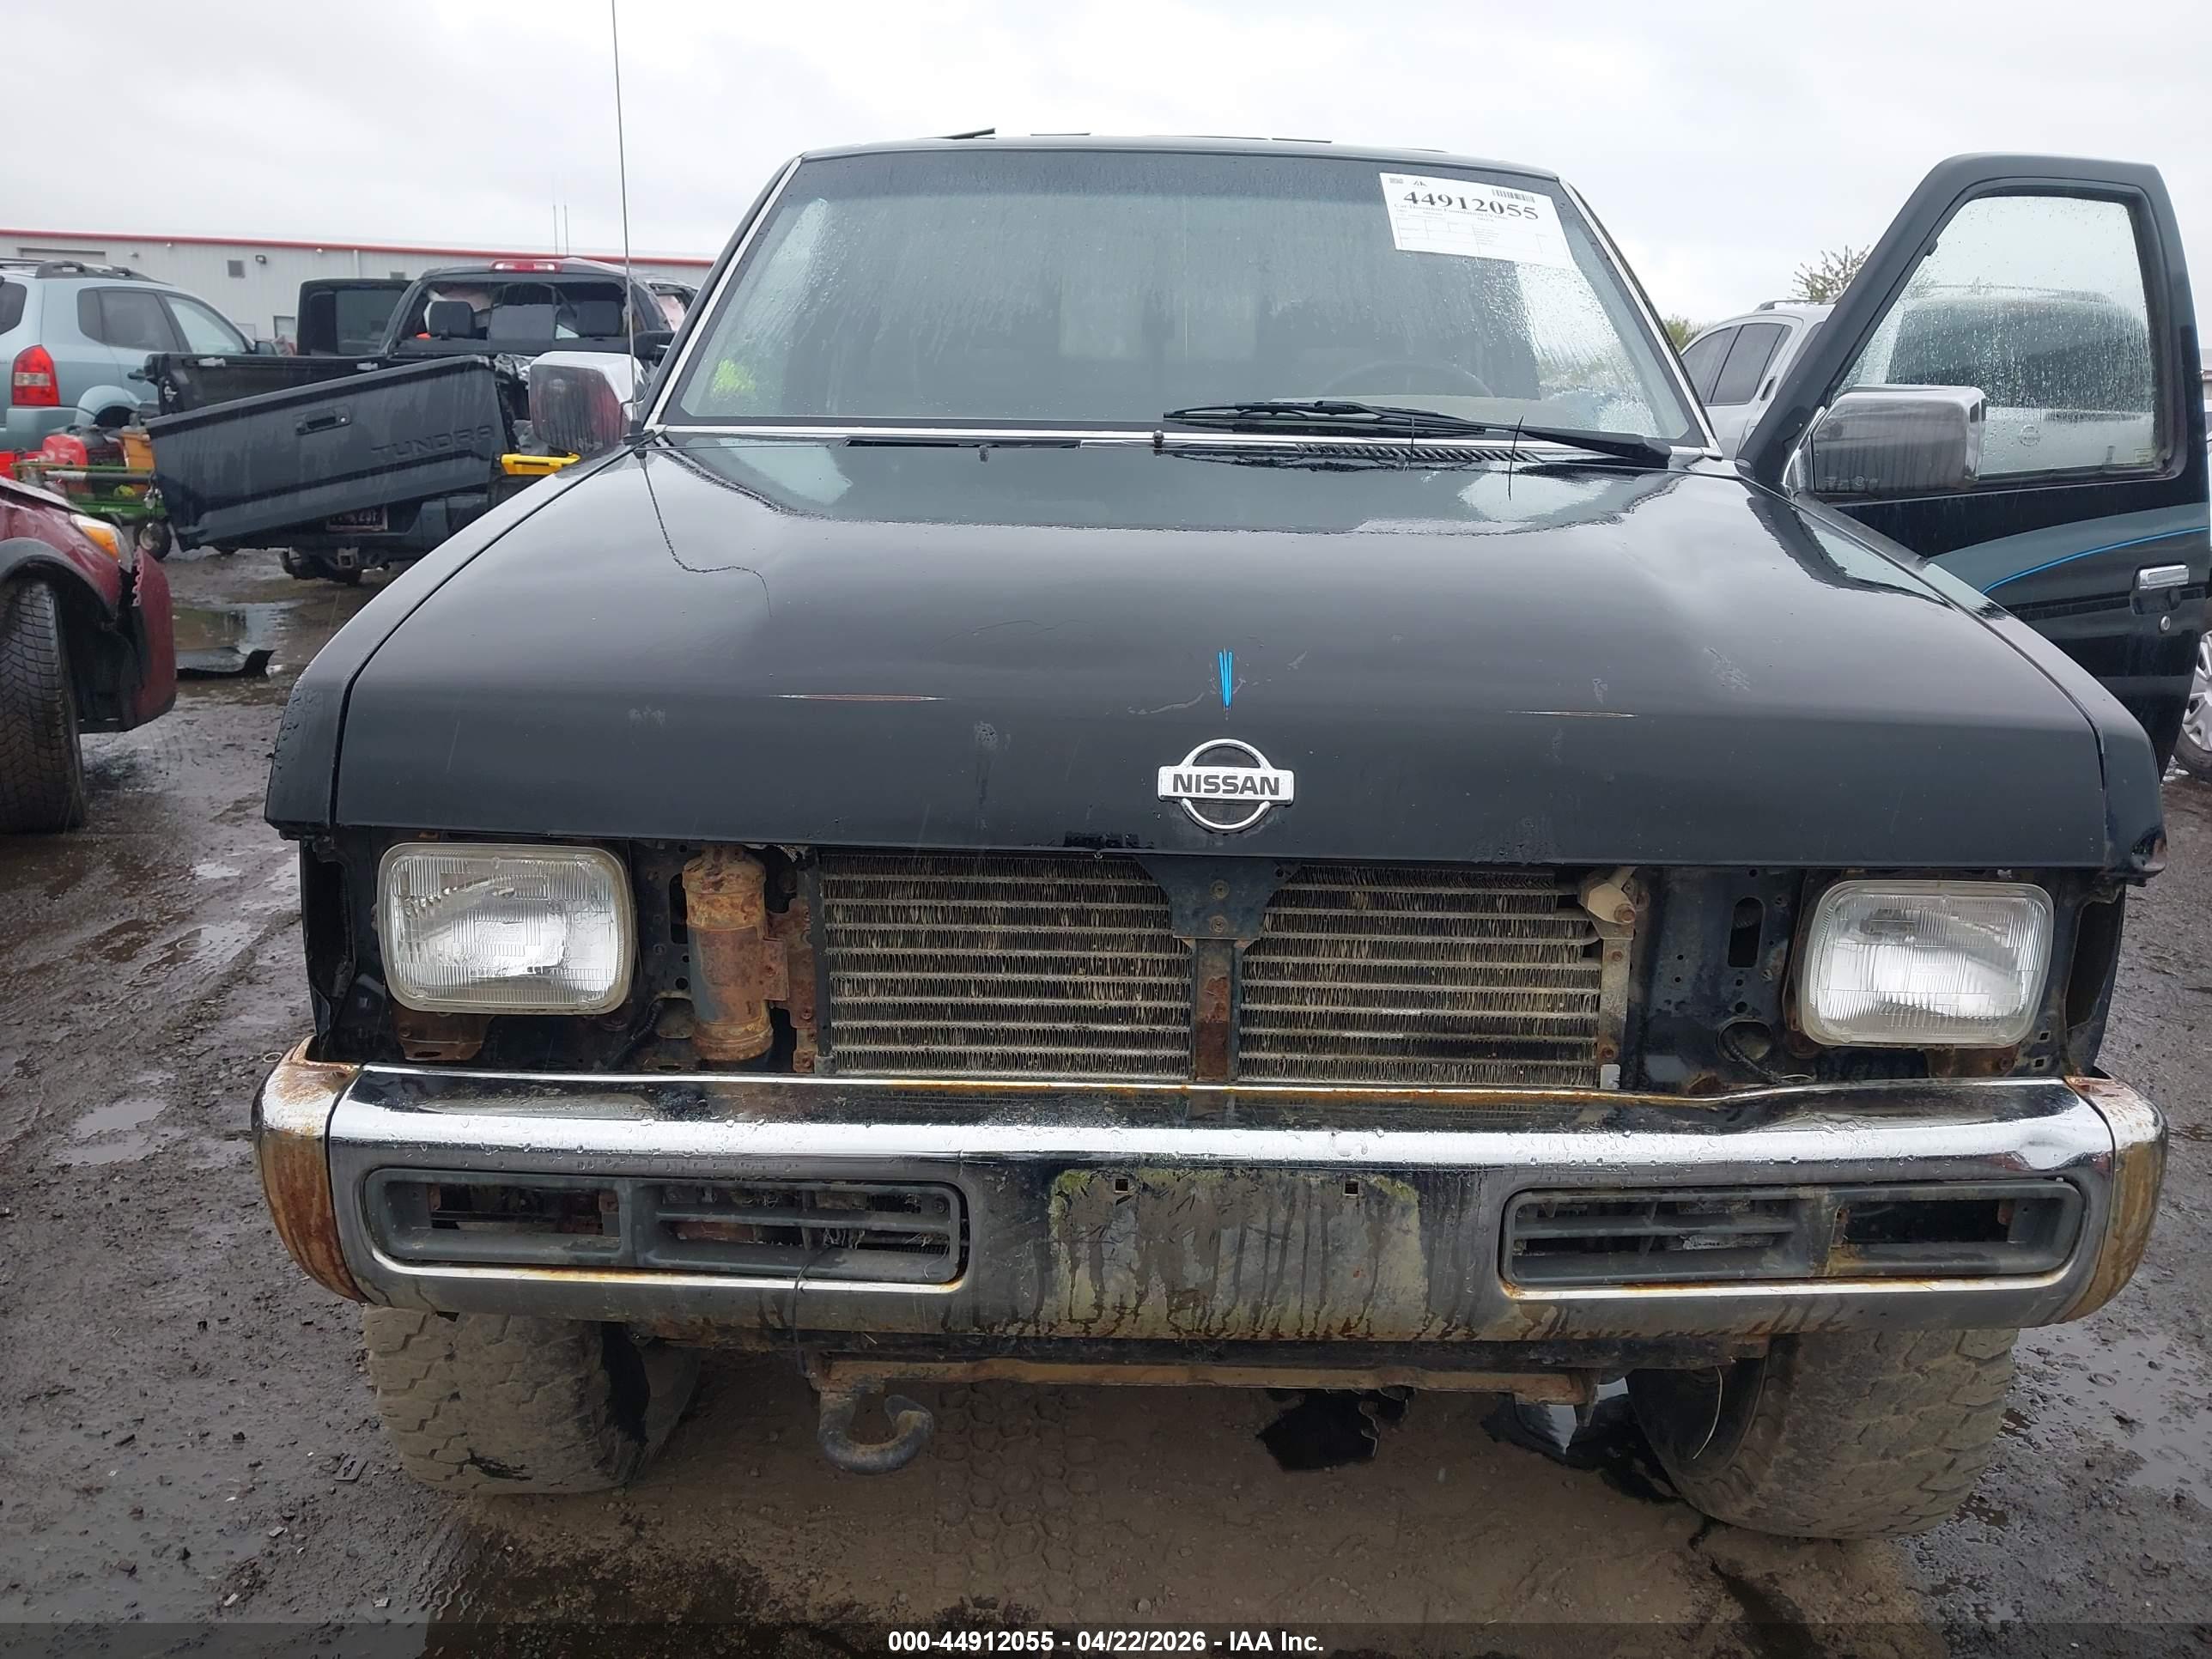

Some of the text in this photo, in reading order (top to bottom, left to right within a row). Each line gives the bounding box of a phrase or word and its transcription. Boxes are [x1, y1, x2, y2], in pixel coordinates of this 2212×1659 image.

[1402, 190, 1540, 221] 44912055
[370, 424, 495, 459] TUNDRA
[1172, 773, 1279, 796] NISSAN
